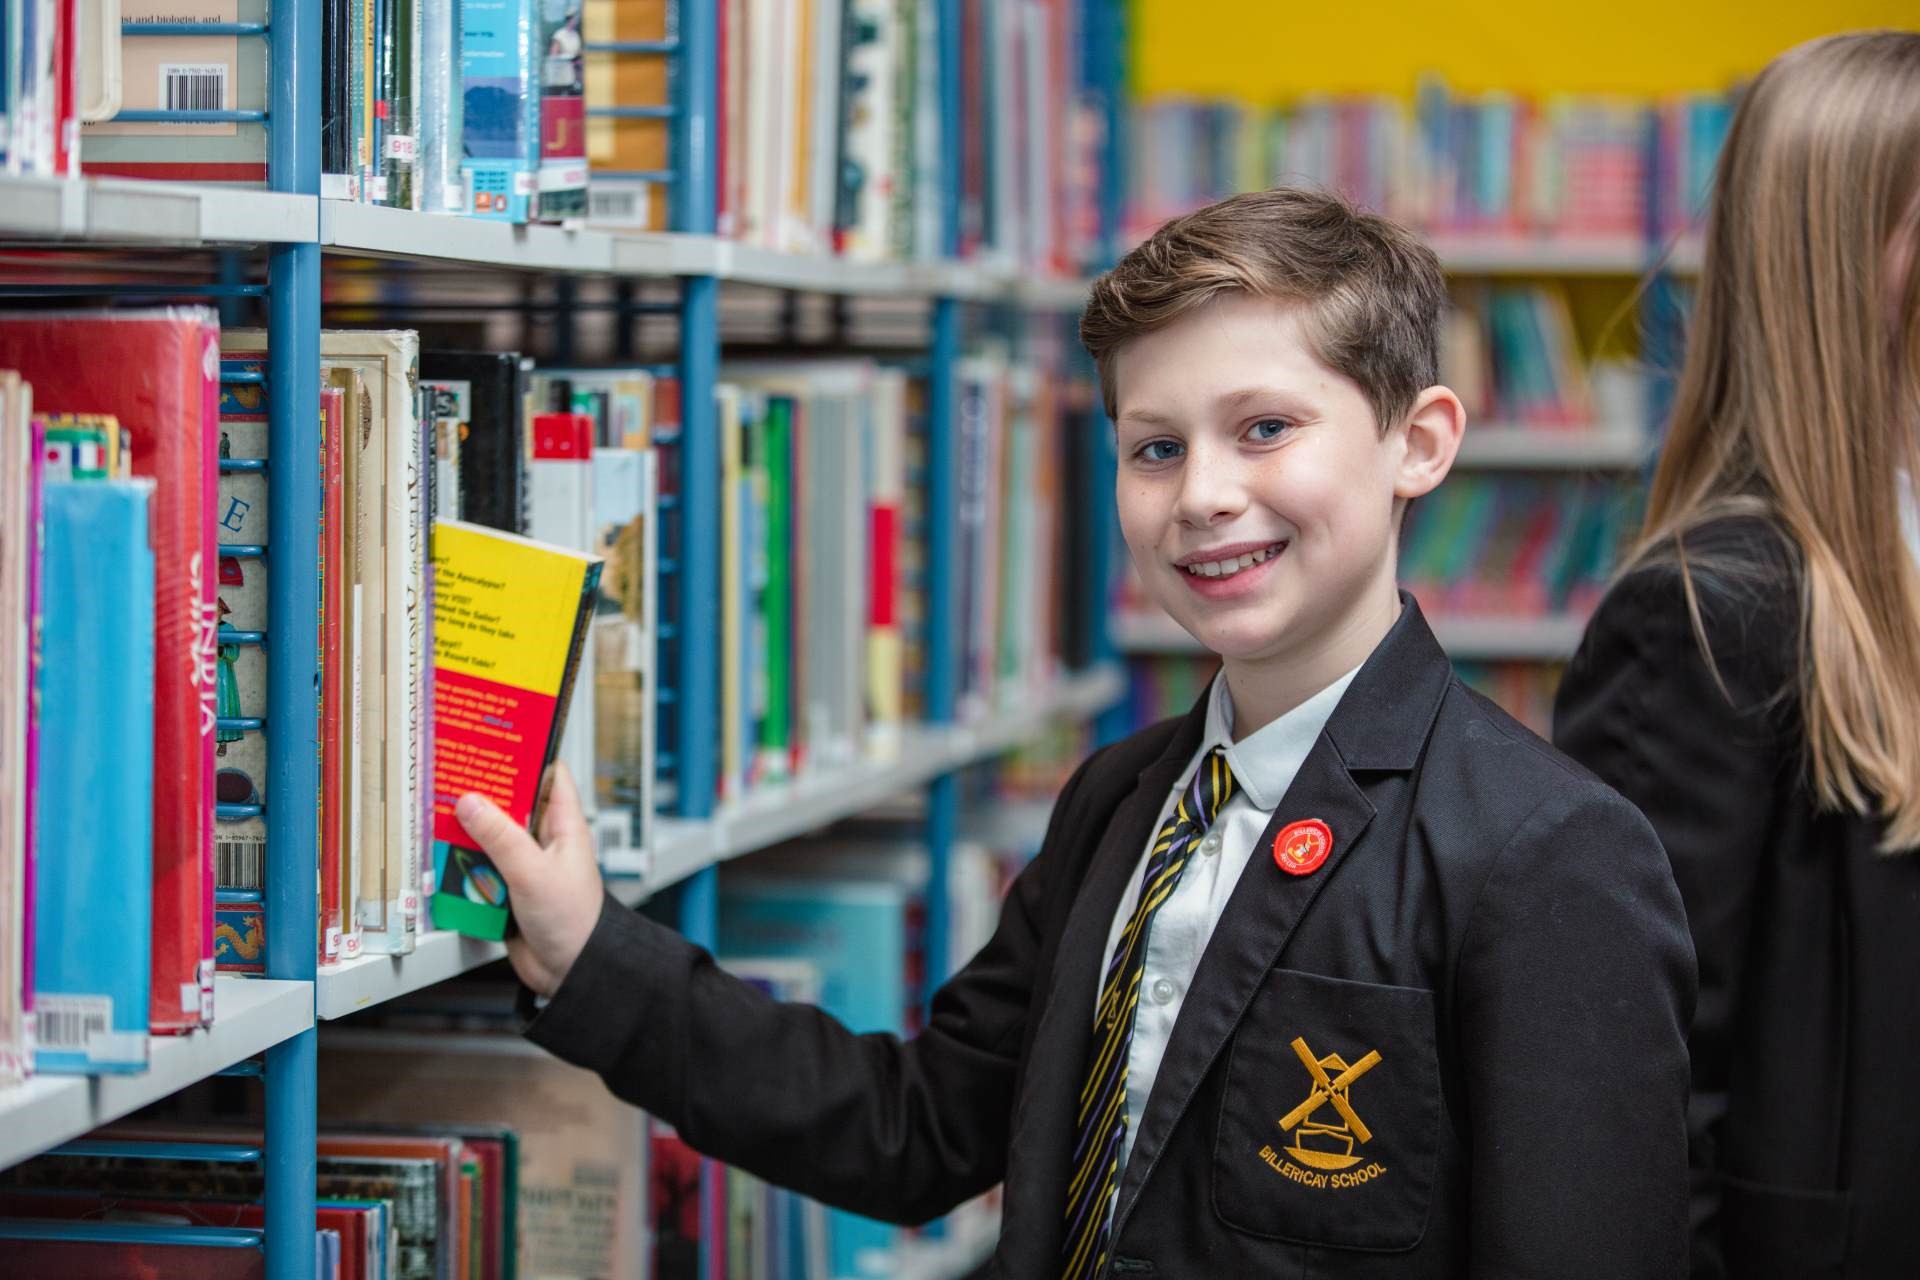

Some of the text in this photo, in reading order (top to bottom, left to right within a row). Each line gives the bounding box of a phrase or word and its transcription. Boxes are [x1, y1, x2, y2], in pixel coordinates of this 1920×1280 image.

[135, 14, 154, 24] and
[202, 15, 221, 24] and
[218, 496, 250, 533] E
[457, 573, 506, 591] Apocalypse?
[200, 602, 217, 738] INDIA
[444, 651, 470, 663] Round
[471, 657, 496, 668] Table?
[1258, 1144, 1387, 1189] BILLERICAY SCHOOL
